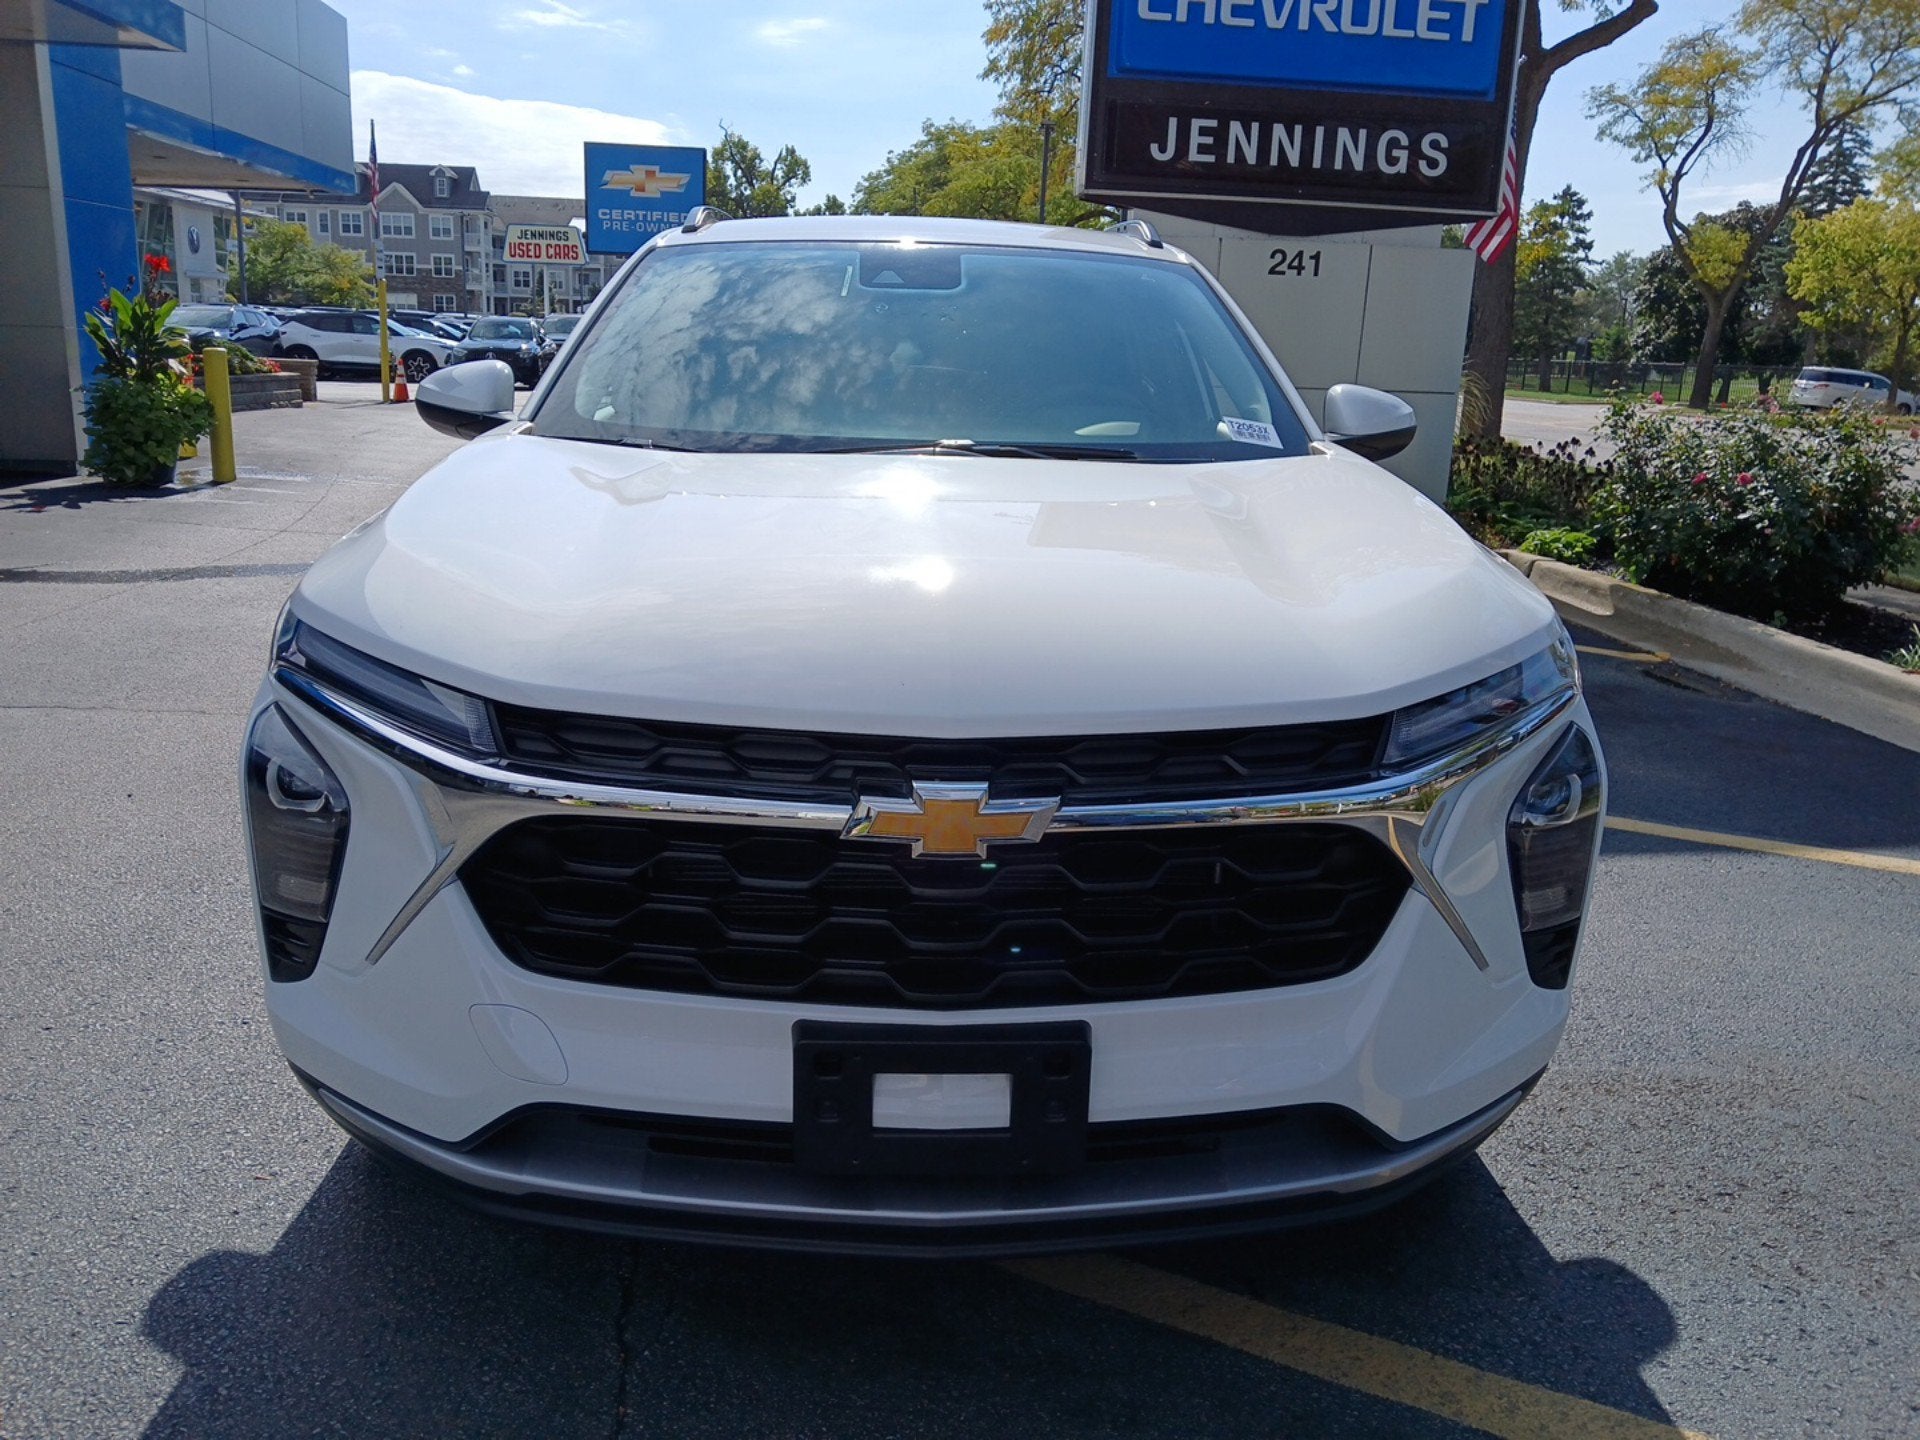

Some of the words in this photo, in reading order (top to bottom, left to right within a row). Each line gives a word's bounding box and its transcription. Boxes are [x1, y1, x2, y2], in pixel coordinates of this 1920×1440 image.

[1150, 116, 1449, 177] JENNINGS
[517, 229, 569, 242] JENNINGS
[509, 242, 542, 259] USED
[546, 243, 579, 260] CARS
[1268, 248, 1321, 277] 241
